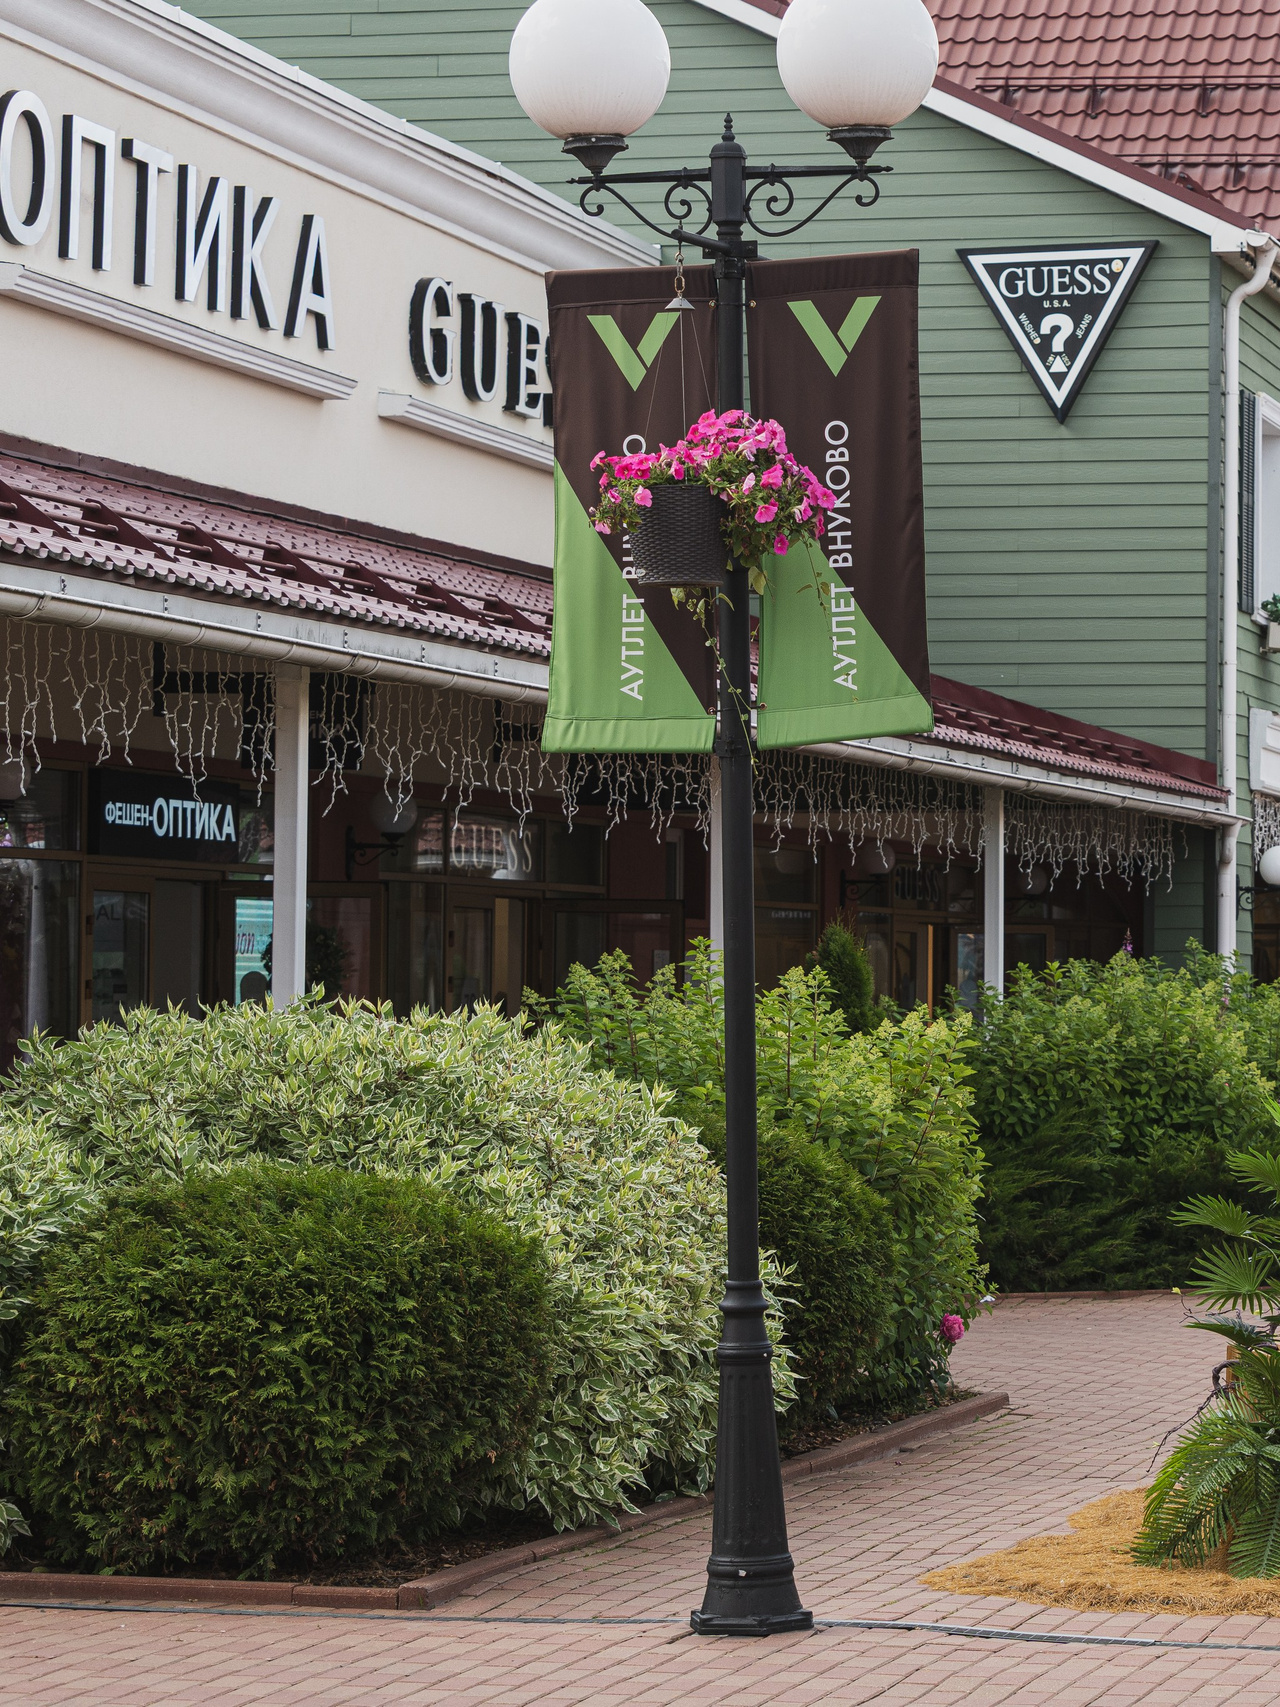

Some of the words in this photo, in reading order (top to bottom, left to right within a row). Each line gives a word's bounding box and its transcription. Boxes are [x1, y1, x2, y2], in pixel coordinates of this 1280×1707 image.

[0, 90, 335, 351] ОПТИКА
[999, 263, 1112, 298] GUESS
[409, 276, 553, 428] GUE
[1018, 312, 1042, 345] WASHED
[1075, 313, 1093, 339] JEANS
[825, 420, 853, 568] ВНУКОВО
[620, 594, 645, 701] АУТЛЕТ
[829, 583, 858, 691] АУТЛЕТ
[105, 797, 236, 841] ФЕШЕН-ОПТИКА
[451, 823, 532, 873] GUESS
